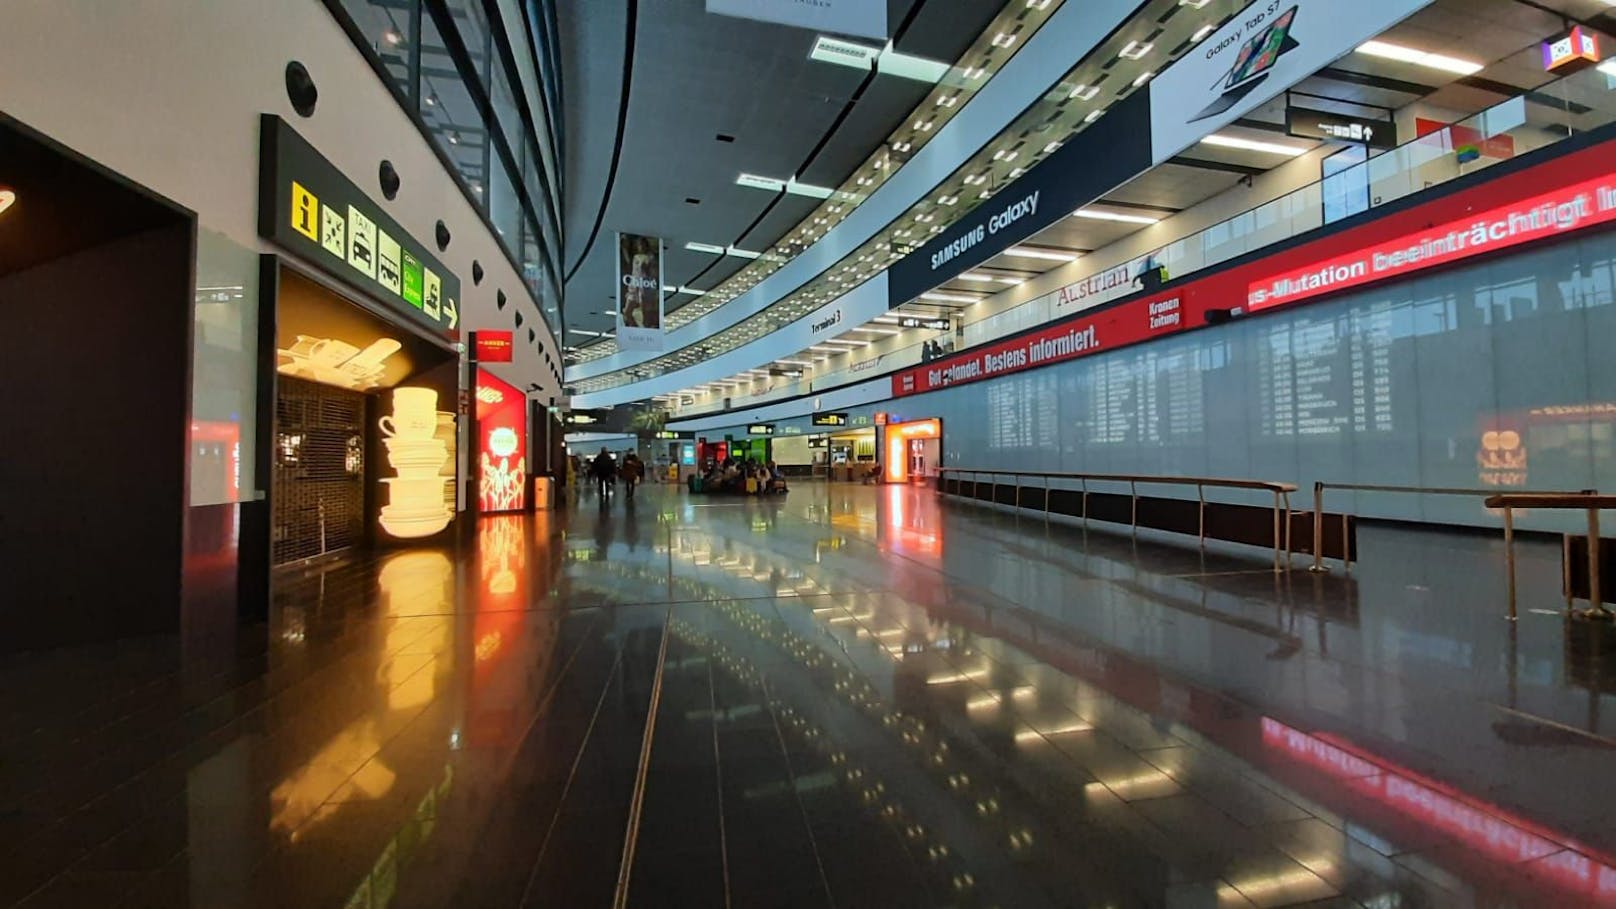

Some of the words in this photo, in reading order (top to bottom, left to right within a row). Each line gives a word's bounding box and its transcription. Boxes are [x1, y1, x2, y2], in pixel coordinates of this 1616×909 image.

[1206, 28, 1242, 60] Galaxy
[1245, 13, 1265, 31] Tab
[931, 224, 985, 270] SAMSUNG
[988, 190, 1039, 235] Galaxy
[812, 313, 836, 335] Terminal
[836, 309, 841, 322] 3
[1149, 297, 1179, 316] Kronen
[928, 370, 942, 387] Gut
[985, 347, 1026, 374] Bestens
[1029, 325, 1099, 363] informiert.
